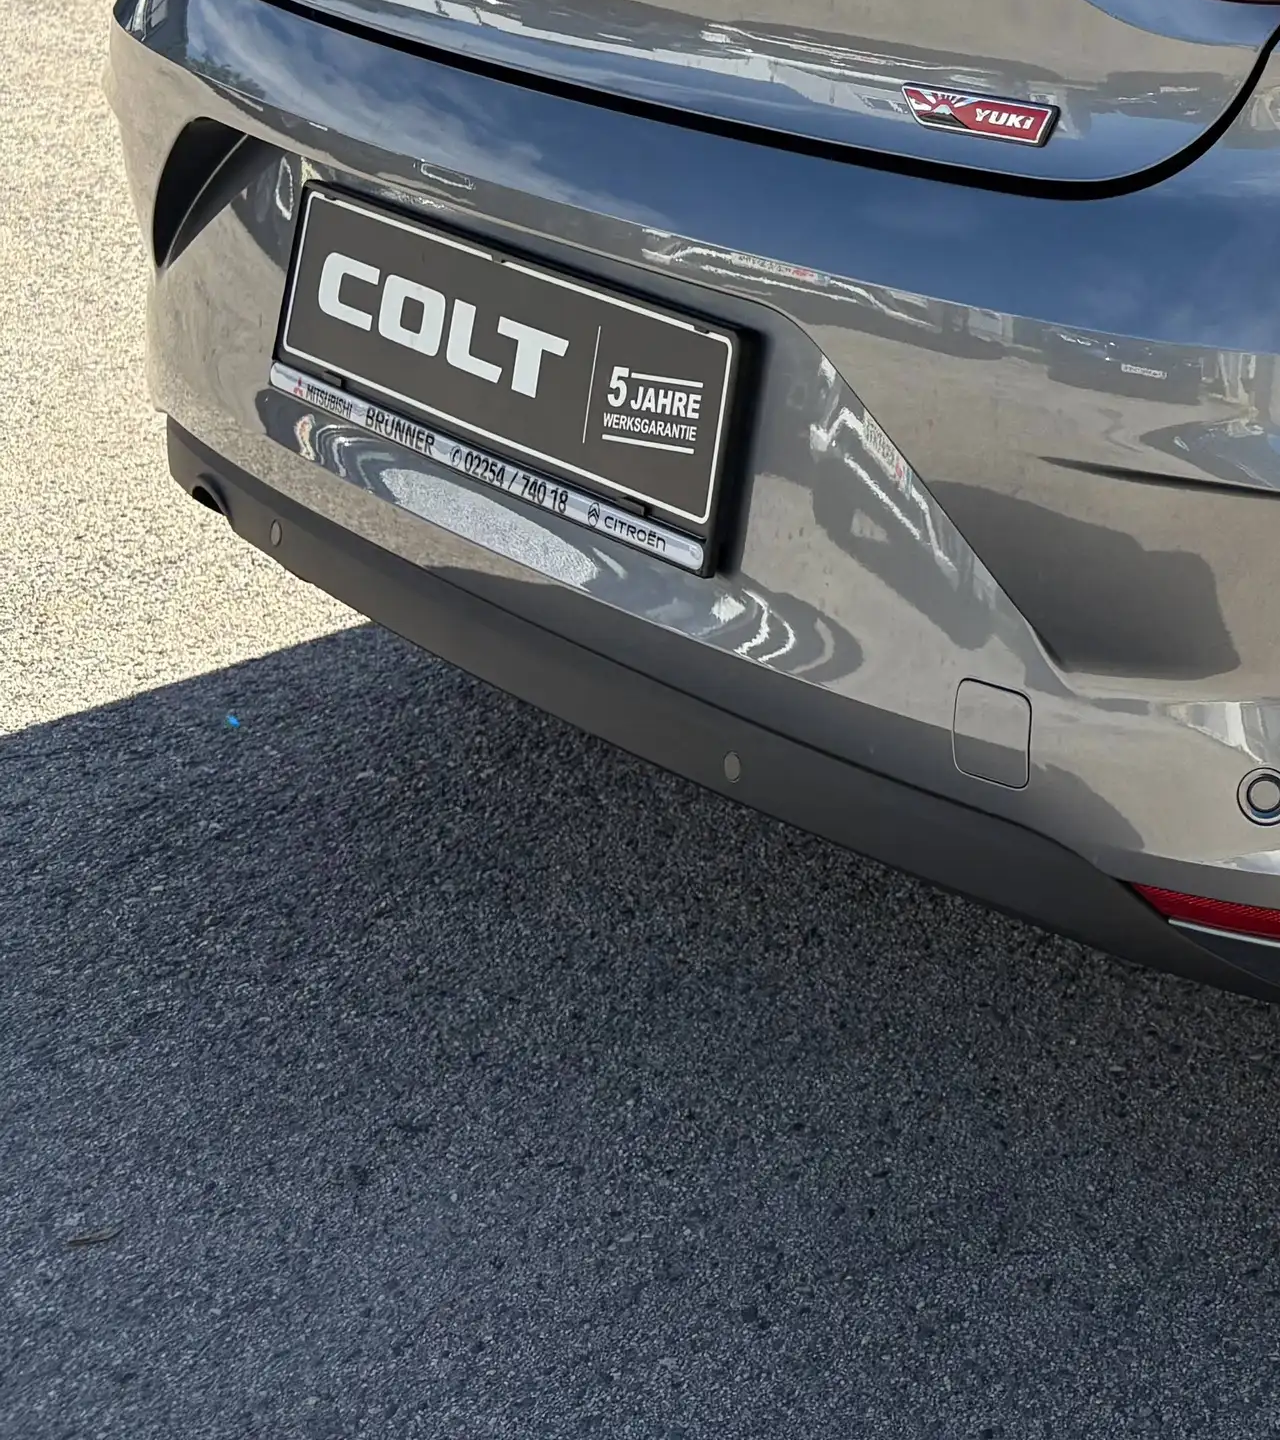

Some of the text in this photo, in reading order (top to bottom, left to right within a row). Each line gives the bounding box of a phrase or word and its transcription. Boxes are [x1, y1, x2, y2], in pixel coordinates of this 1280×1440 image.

[974, 107, 1035, 130] YUKI
[317, 251, 570, 399] COLT
[607, 366, 702, 420] 5 JAHRE
[306, 383, 353, 421] MITSUBISHI
[364, 405, 435, 456] BRUNNER
[465, 451, 506, 488] 02254
[521, 474, 547, 505] 740
[551, 487, 569, 514] 18
[603, 412, 697, 442] WERKSGARANTIE
